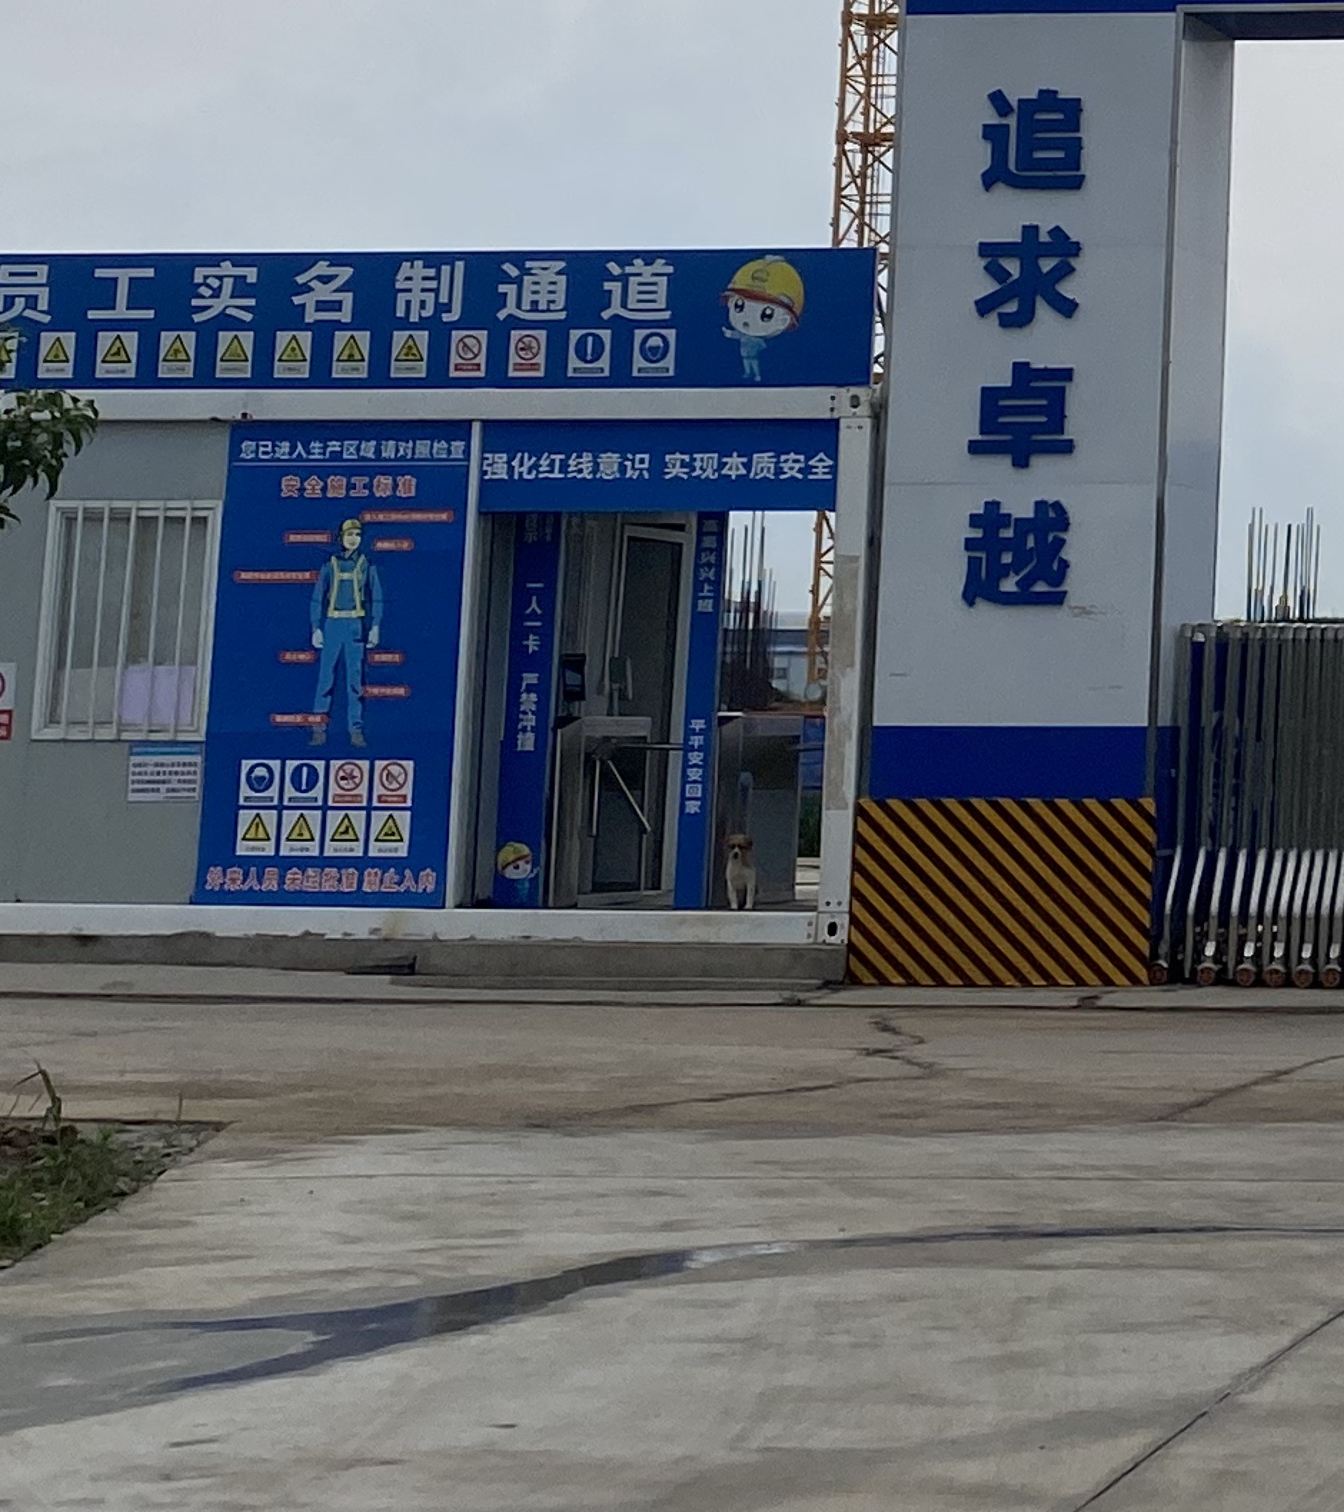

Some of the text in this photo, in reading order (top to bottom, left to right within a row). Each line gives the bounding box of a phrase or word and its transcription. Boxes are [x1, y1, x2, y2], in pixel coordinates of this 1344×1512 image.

[0, 258, 675, 324] 员工实名制通道
[962, 89, 1086, 608] 追求卓越
[239, 440, 466, 460] 您已进入生产区域 请对照检查
[482, 452, 835, 481] 强化红线意识 实现本质安全
[280, 475, 417, 498] 安全施工标准
[522, 582, 544, 654] 一人一卡
[684, 719, 706, 814] 平平安安回家
[206, 866, 279, 891] 外来人员
[362, 867, 437, 893] 禁止入内
